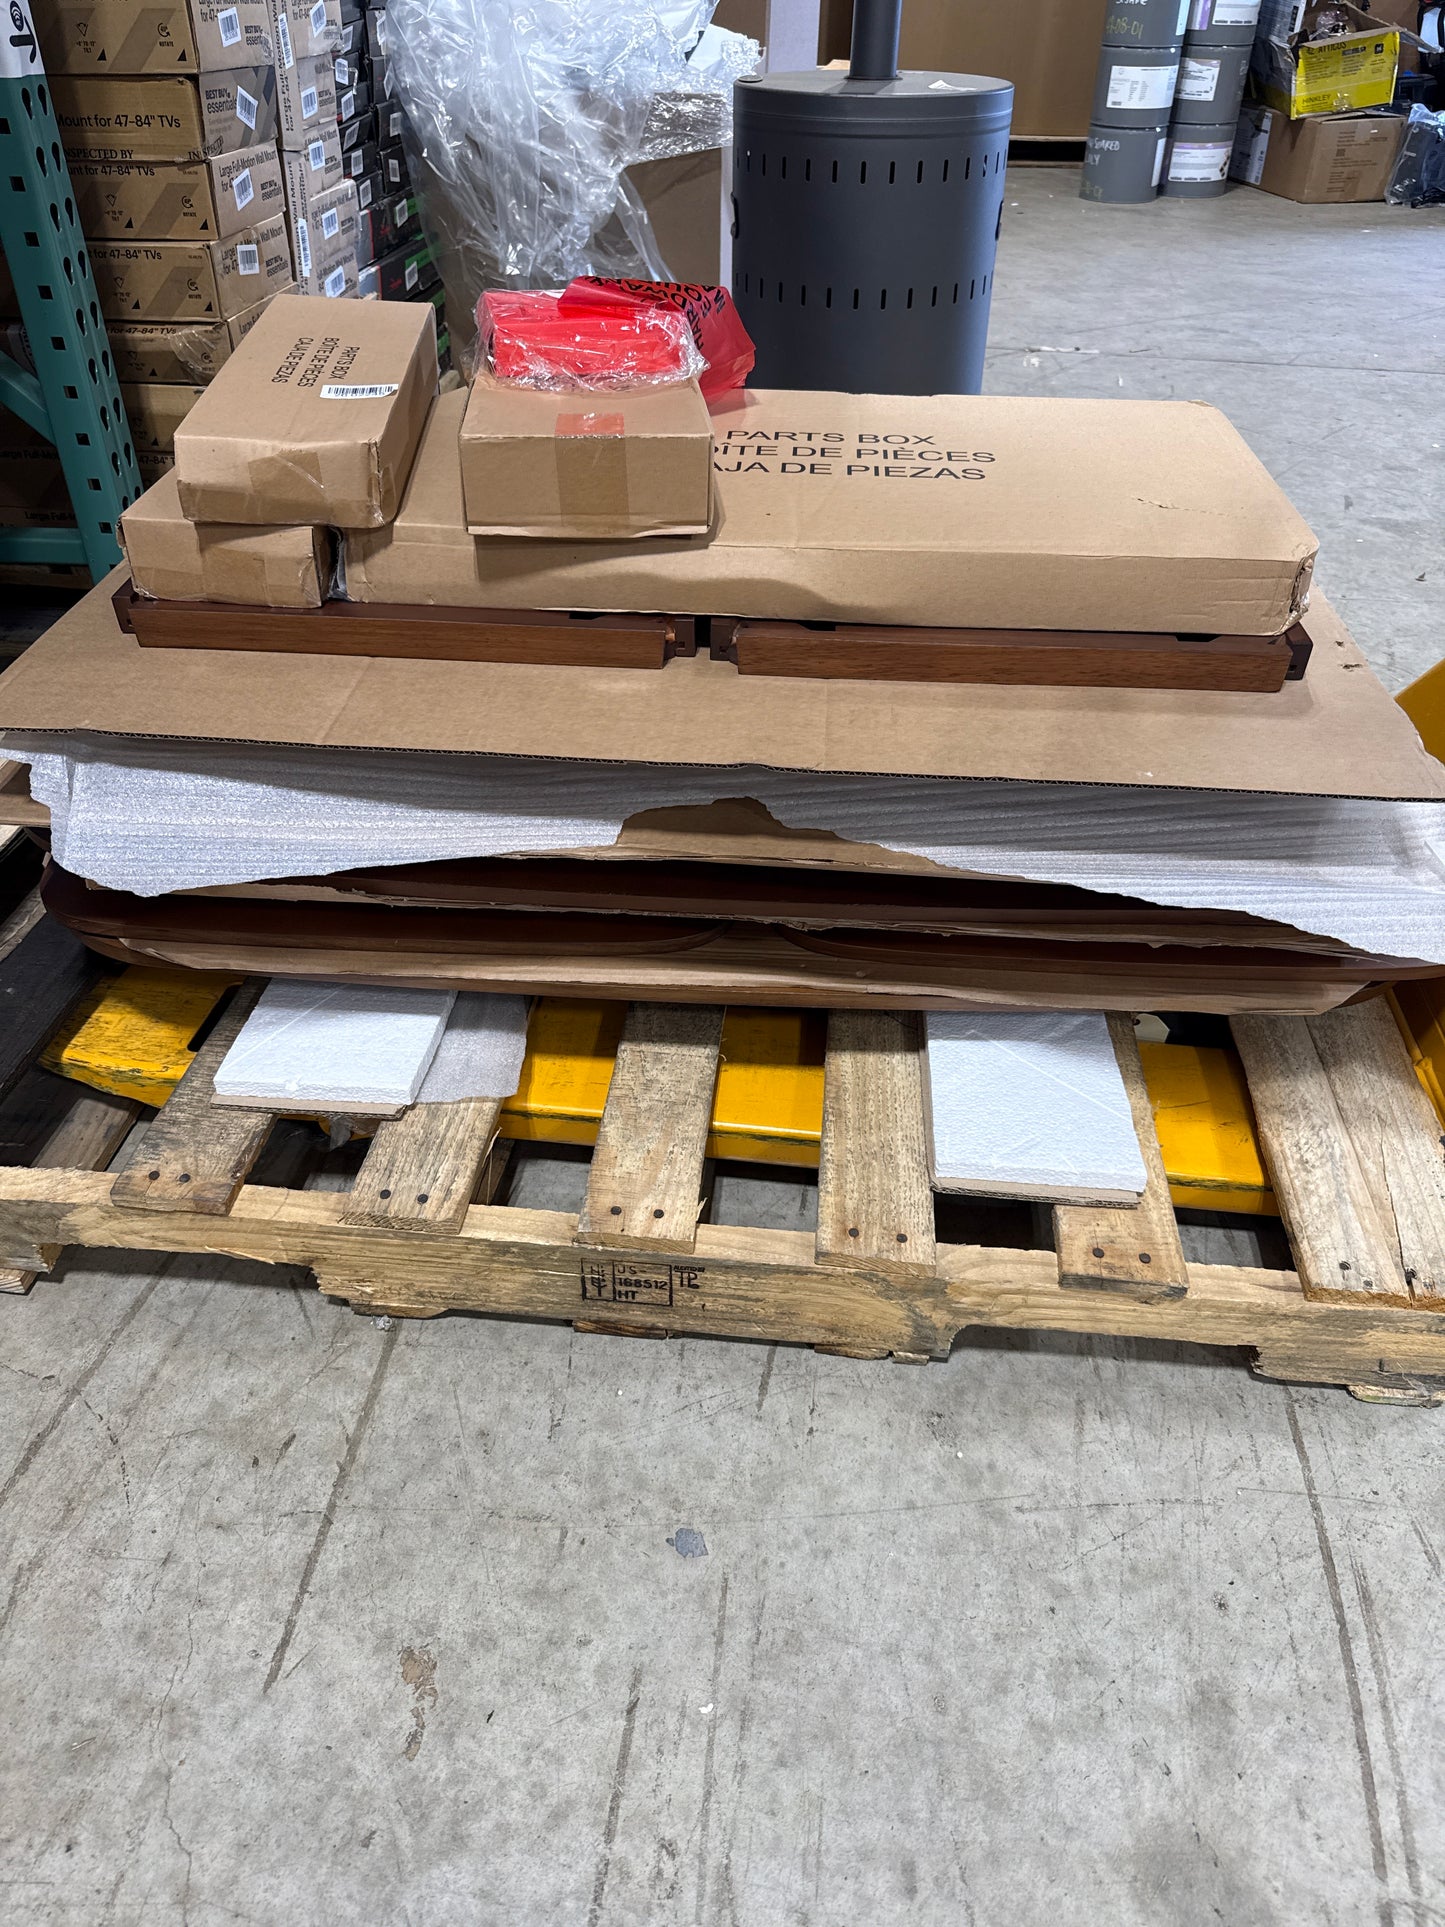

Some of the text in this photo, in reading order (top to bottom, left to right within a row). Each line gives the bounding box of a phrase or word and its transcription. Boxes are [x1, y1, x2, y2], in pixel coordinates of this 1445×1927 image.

[205, 89, 217, 100] BEST
[95, 114, 111, 127] for
[114, 114, 155, 127] 47-84"
[158, 114, 181, 128] TVs
[120, 150, 133, 160] BY
[84, 165, 99, 176] for
[101, 165, 134, 176] 47-84"
[136, 166, 155, 176] TVs
[94, 250, 107, 260] for
[109, 249, 141, 260] 47-84"
[144, 250, 162, 260] TVs
[271, 337, 314, 383] CAJA DE PIEZAS
[311, 354, 330, 363] DE
[328, 346, 360, 380] PARTS BOX
[297, 363, 325, 387] PIÈCES
[727, 430, 936, 445] PARTS BOX
[792, 446, 843, 458] DE
[856, 447, 996, 463] PIÈCES
[780, 462, 832, 475] DE
[846, 464, 986, 480] PIEZAS
[617, 1290, 639, 1300] HT
